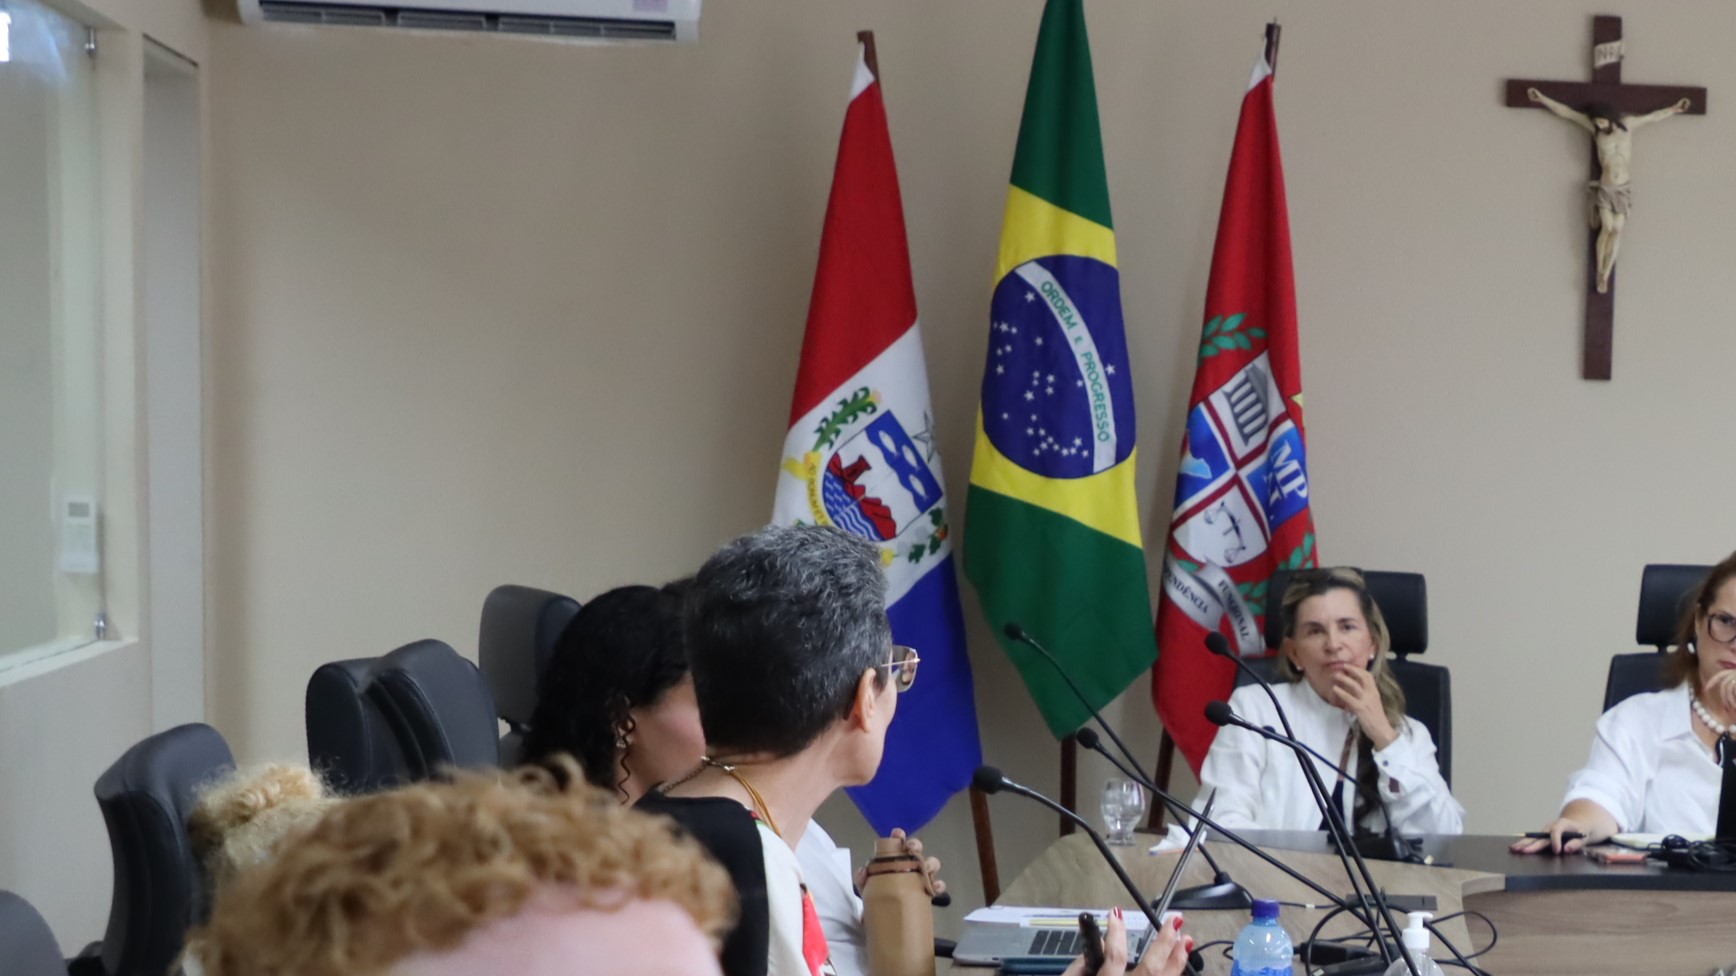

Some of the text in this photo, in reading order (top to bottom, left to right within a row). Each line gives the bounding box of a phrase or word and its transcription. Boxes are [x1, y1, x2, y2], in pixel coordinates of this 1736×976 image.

[1040, 281, 1110, 443] ORDEM E PROGRESSO
[1270, 440, 1308, 499] MP
